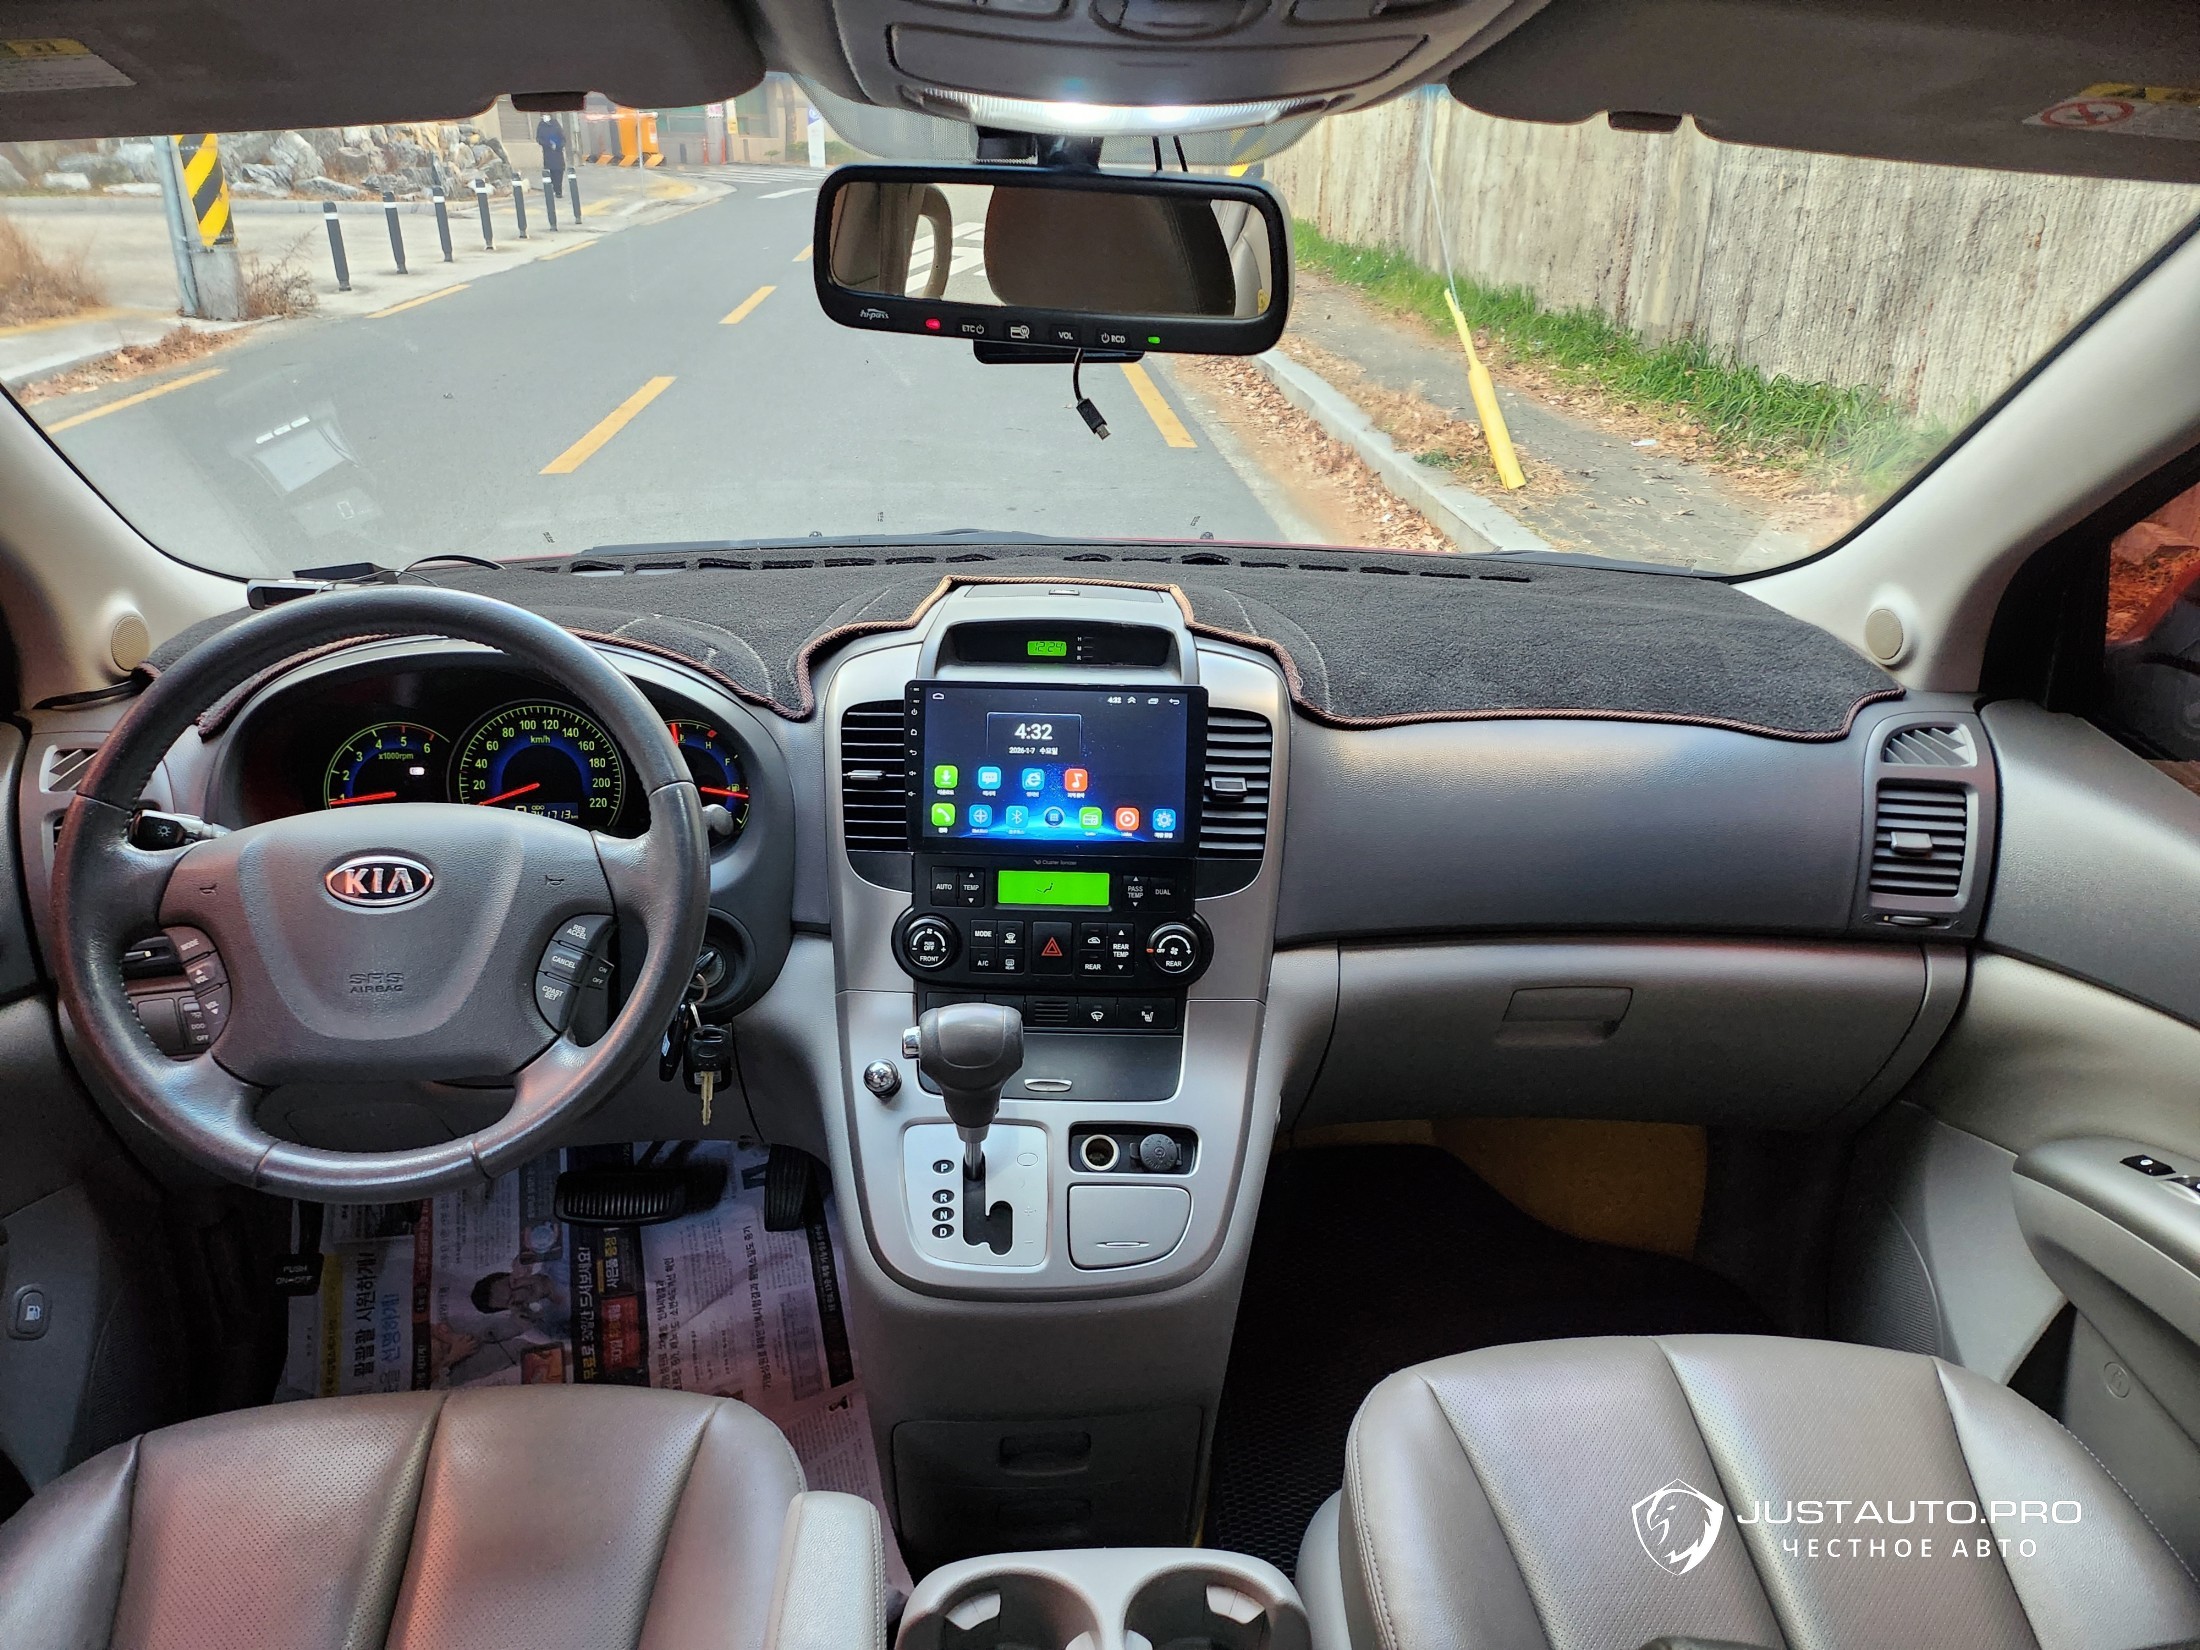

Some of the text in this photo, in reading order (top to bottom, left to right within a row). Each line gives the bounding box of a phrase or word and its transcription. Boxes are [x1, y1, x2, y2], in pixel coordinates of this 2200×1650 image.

[961, 324, 976, 333] ETC
[1057, 330, 1074, 341] VOL
[1110, 334, 1126, 344] RCD
[519, 720, 537, 730] 100
[542, 719, 560, 730] 120
[502, 727, 515, 738] 80
[562, 727, 579, 738] 140
[1014, 723, 1053, 740] 4:32
[375, 739, 383, 750] 4
[400, 736, 408, 747] 5
[530, 735, 551, 744] km/h
[423, 742, 431, 754] 6
[486, 740, 499, 751] 60
[577, 740, 595, 751] 160
[705, 741, 712, 750] H
[356, 751, 363, 762] 3
[724, 757, 731, 766] F
[474, 758, 488, 769] 40
[588, 757, 606, 768] 180
[342, 770, 350, 781] 2
[473, 780, 486, 790] 20
[592, 778, 611, 788] 200
[589, 797, 608, 808] 220
[344, 867, 414, 894] KIA
[935, 883, 953, 891] AUTO
[566, 928, 587, 940] ACCEL
[974, 930, 992, 938] MODE
[551, 955, 576, 969] CANCEL
[350, 984, 404, 994] AIRBAG
[542, 985, 564, 997] COAST
[544, 992, 558, 1001] SET
[940, 1163, 949, 1172] P
[940, 1193, 948, 1202] R
[940, 1211, 948, 1220] N
[939, 1227, 948, 1237] D
[283, 1265, 308, 1273] PUSH
[605, 1258, 620, 1288] 사은품
[577, 1247, 594, 1308] 드셔보세요!
[356, 1252, 377, 1322] 시원하게!
[380, 1293, 401, 1362] 선명하게!
[581, 1344, 598, 1380] 무료로
